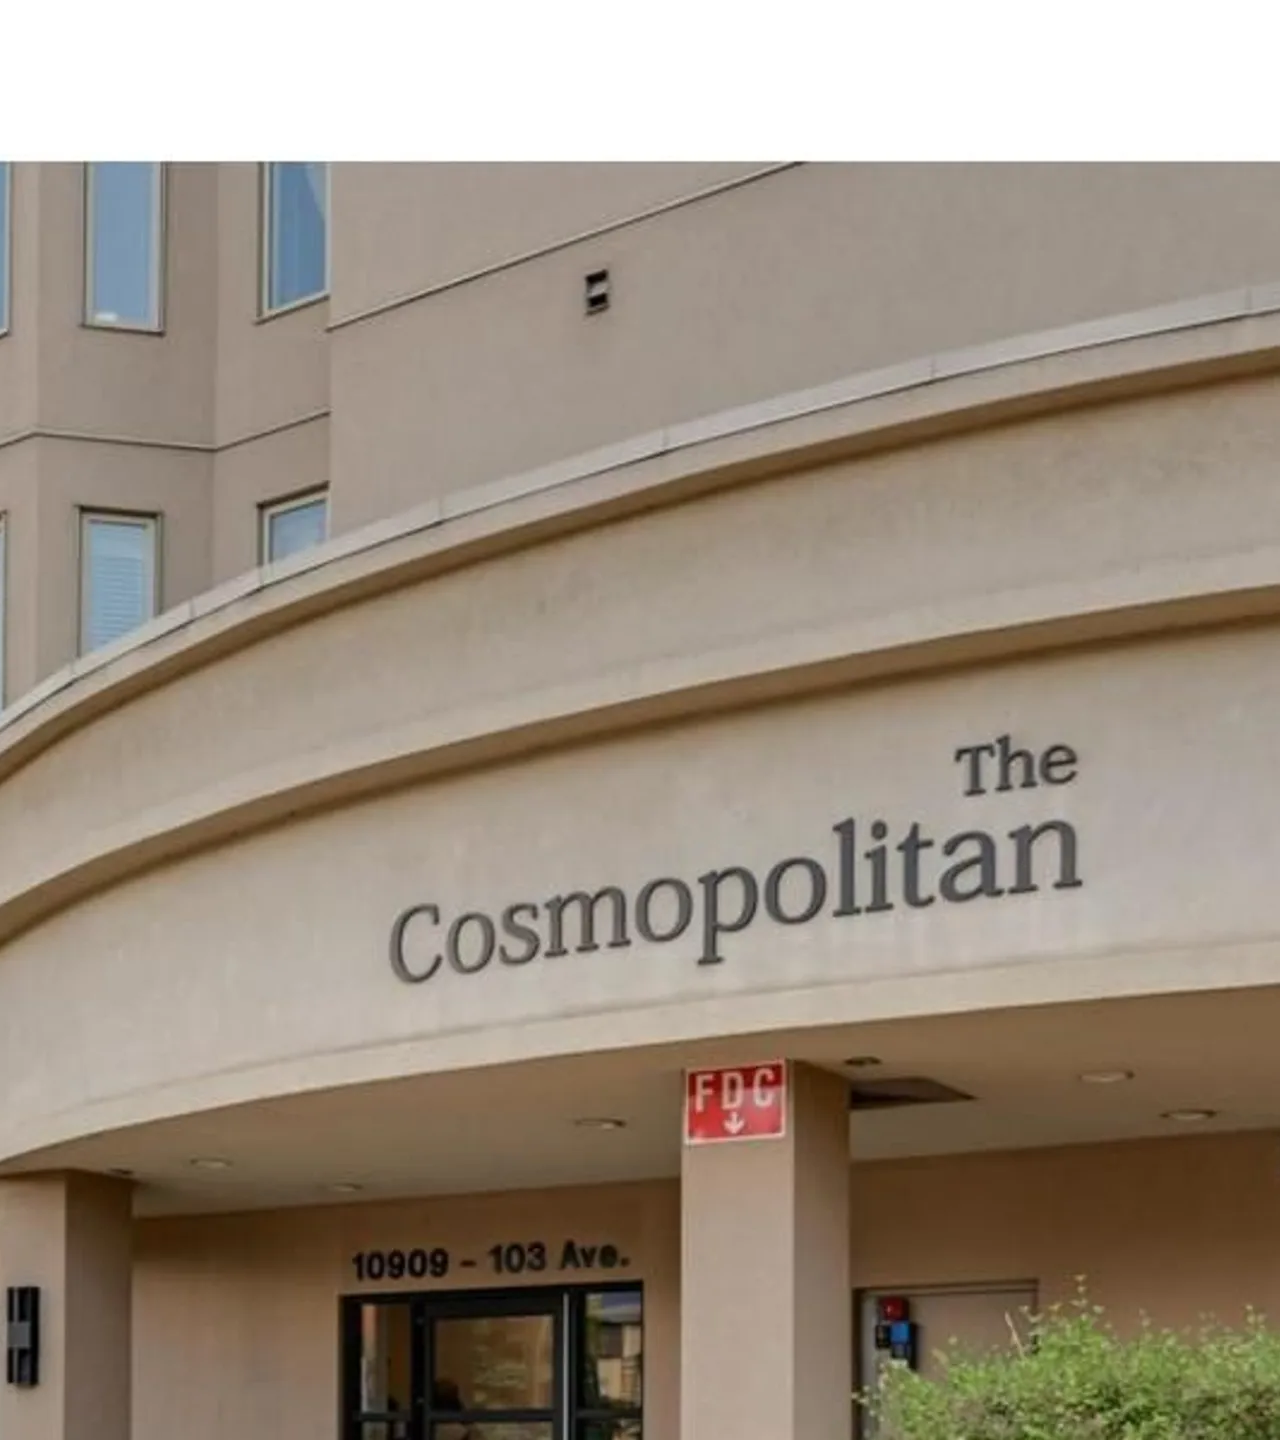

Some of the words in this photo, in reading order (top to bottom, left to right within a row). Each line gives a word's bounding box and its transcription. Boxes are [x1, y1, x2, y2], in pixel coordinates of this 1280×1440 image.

[955, 736, 1078, 796] The
[390, 817, 1083, 984] Cosmopolitan
[693, 1067, 776, 1113] FDC
[352, 1248, 449, 1281] 10909
[488, 1242, 547, 1274] 103
[559, 1240, 630, 1270] Ave.
